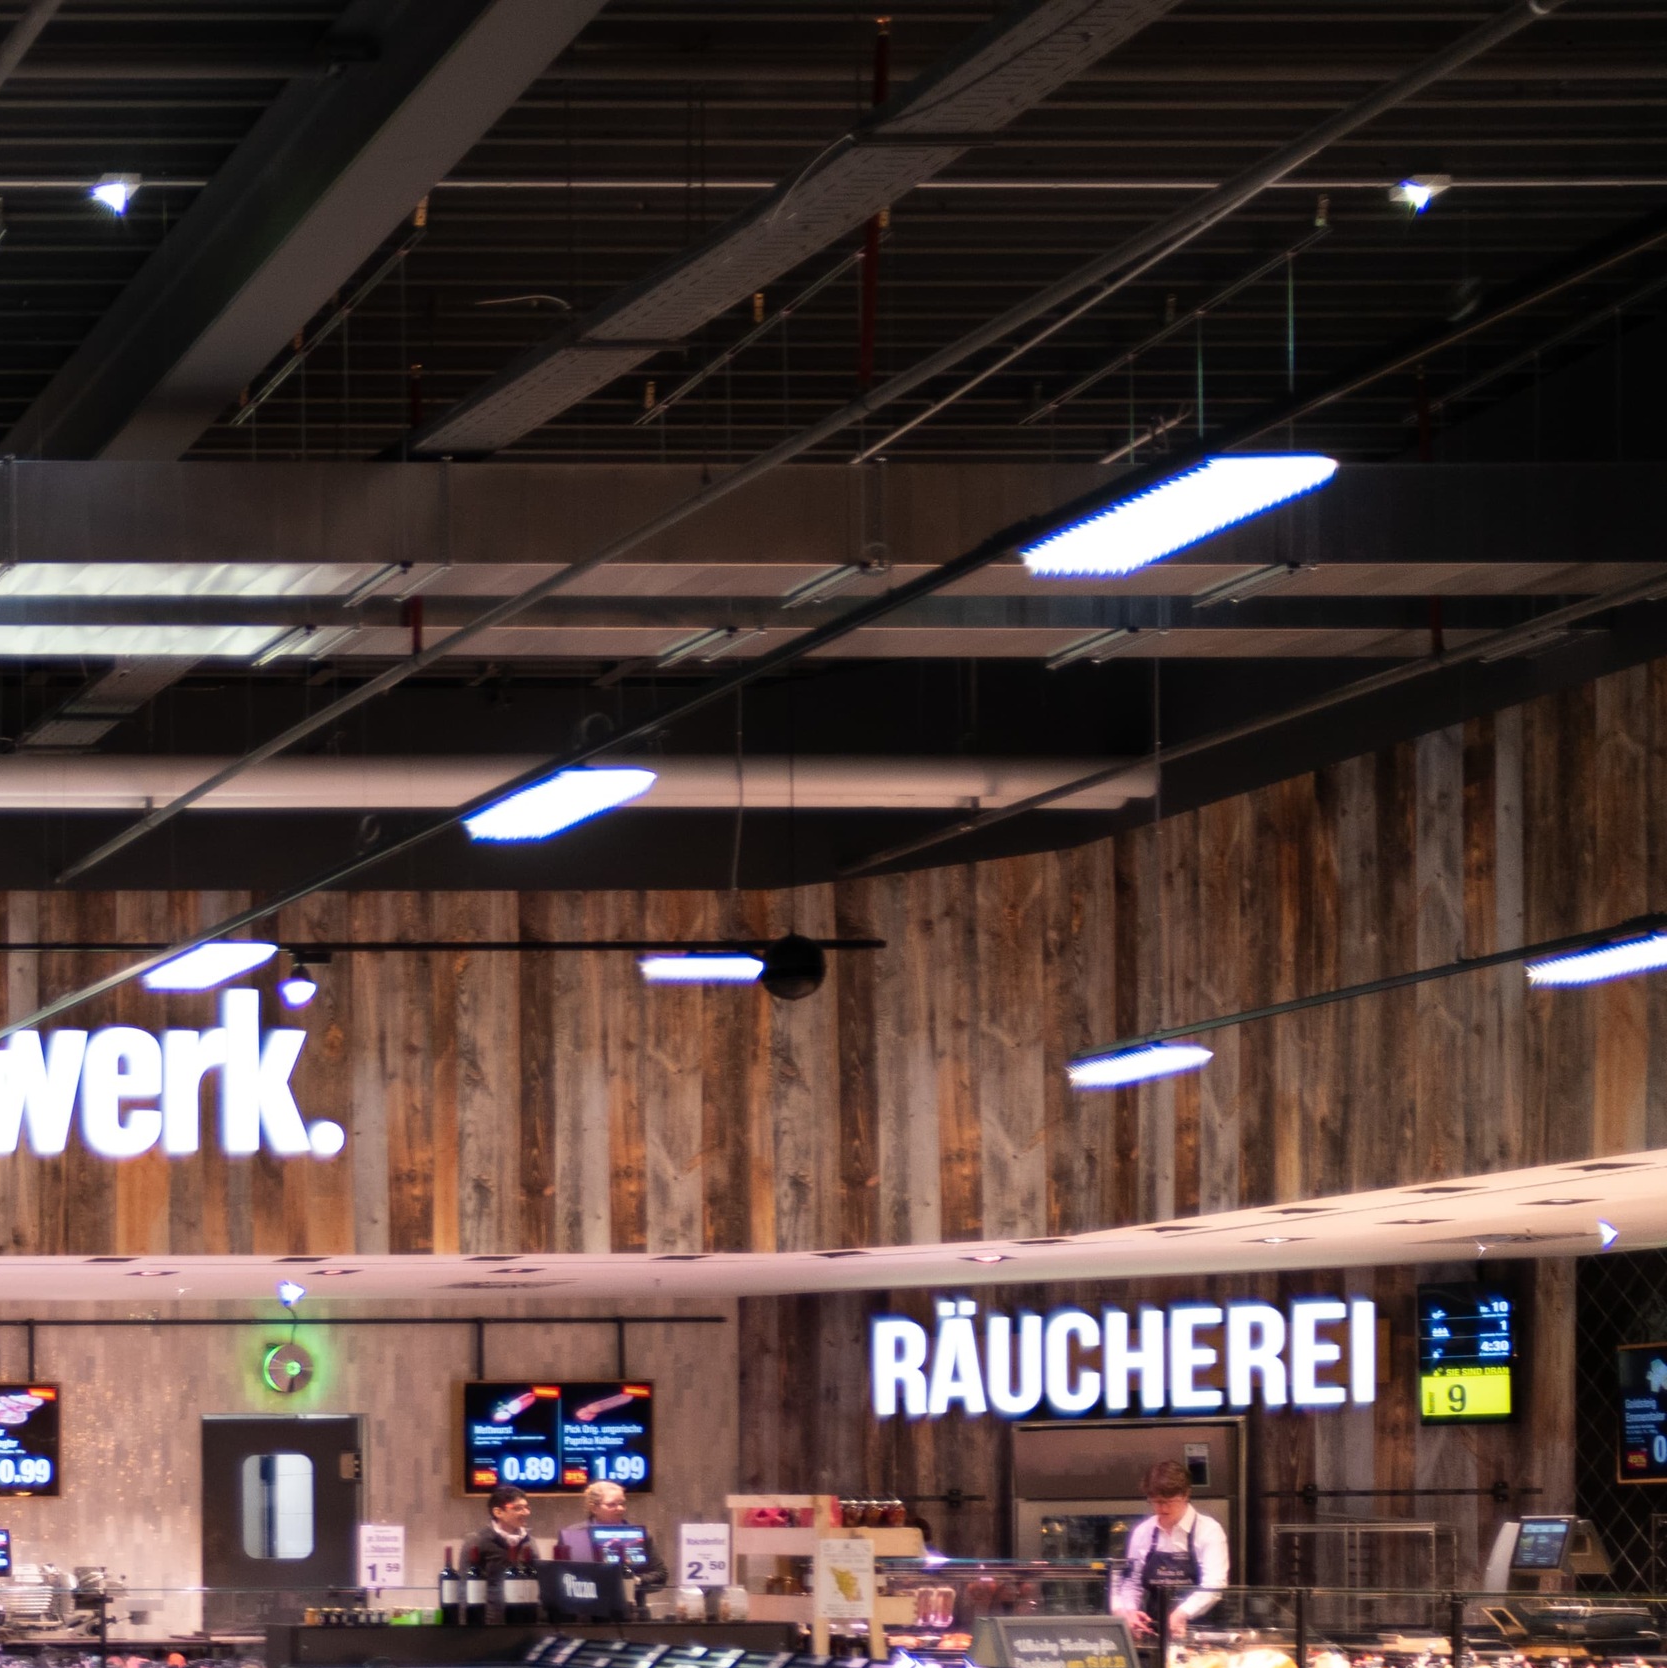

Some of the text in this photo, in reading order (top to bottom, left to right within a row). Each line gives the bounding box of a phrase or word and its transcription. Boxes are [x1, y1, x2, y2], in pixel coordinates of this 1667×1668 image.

[1492, 1301, 1509, 1312] 10
[1500, 1320, 1507, 1331] 1
[873, 1299, 1376, 1416] RÄUCHEREI
[1446, 1366, 1510, 1377] SIE SIND DRAN
[1448, 1383, 1466, 1413] 9
[503, 1456, 556, 1481] 0.89
[595, 1455, 646, 1480] 1.99
